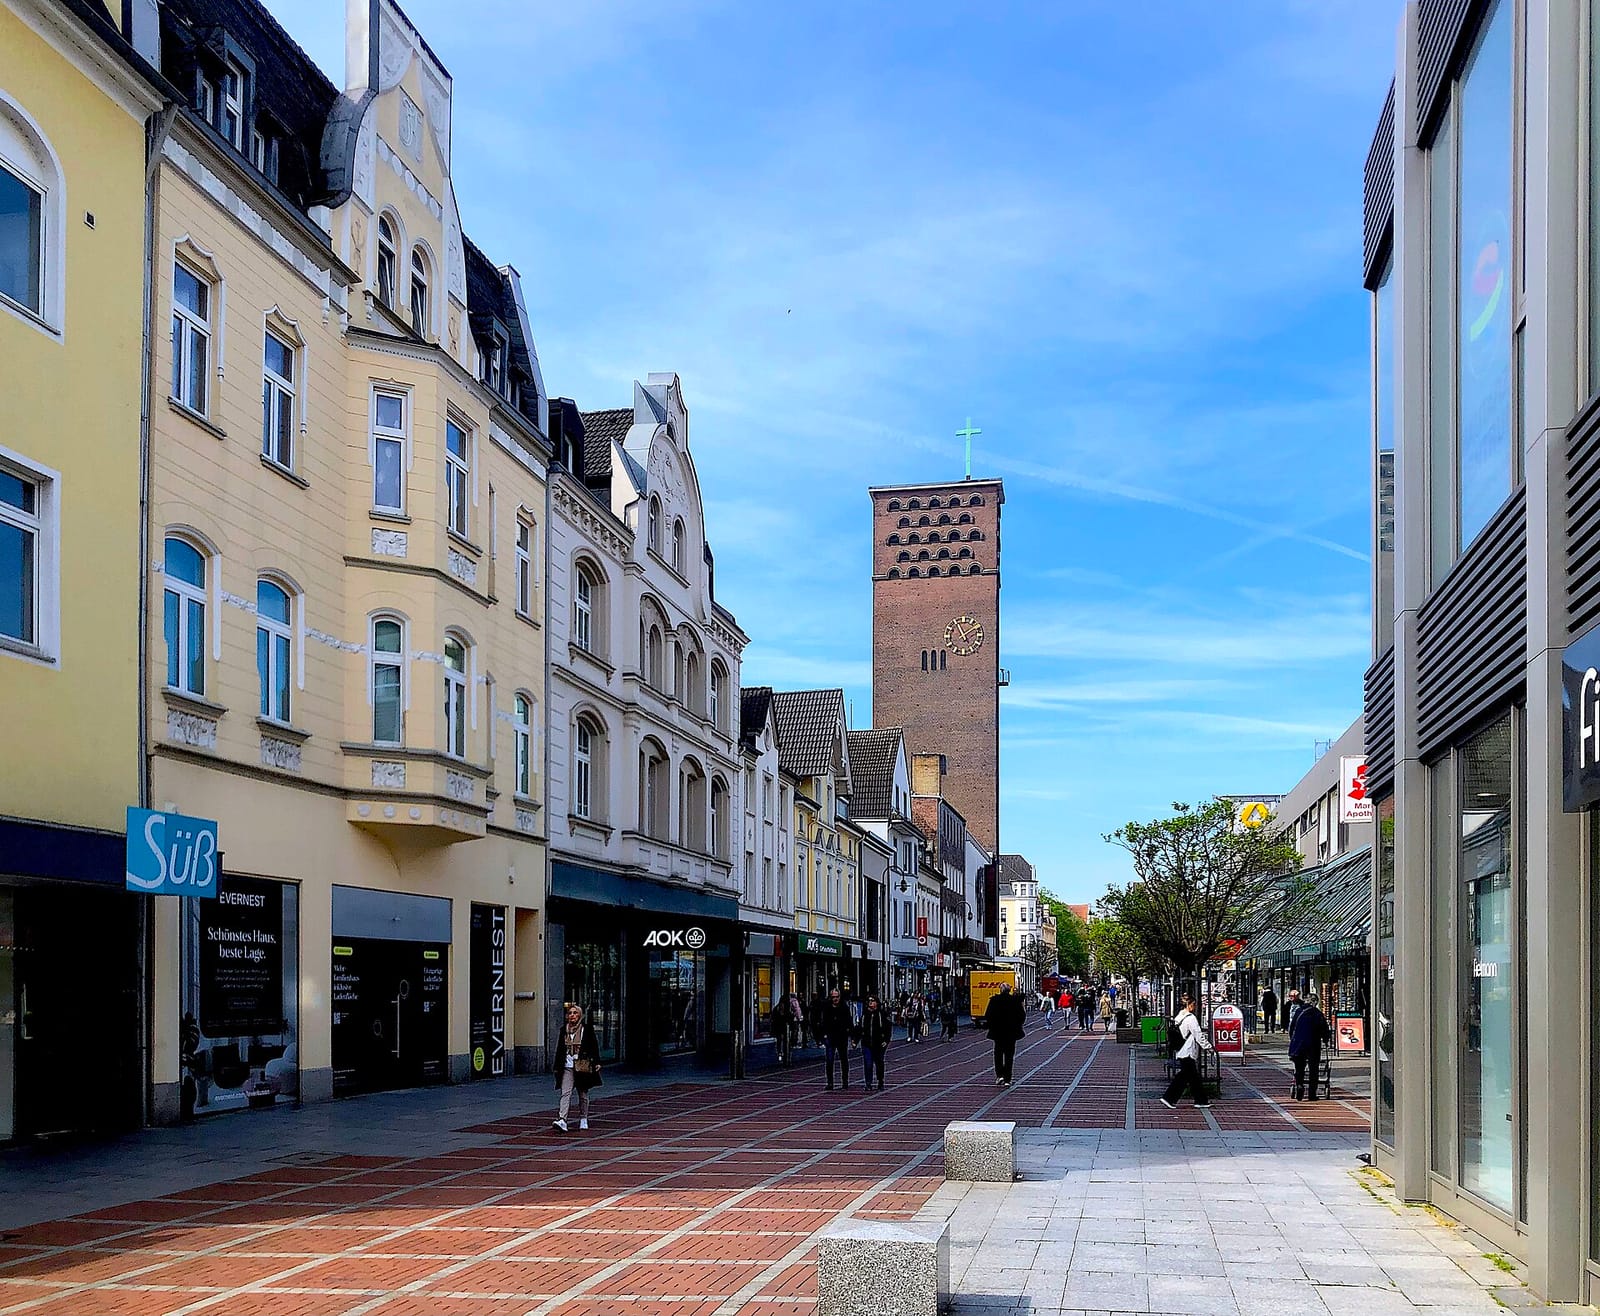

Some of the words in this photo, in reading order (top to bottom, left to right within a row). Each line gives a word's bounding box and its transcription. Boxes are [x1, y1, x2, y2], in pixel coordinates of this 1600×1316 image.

[127, 814, 215, 889] Süß
[219, 892, 265, 907] EVERNEST
[207, 926, 252, 942] Schönstes
[642, 929, 684, 947] AOK
[219, 943, 243, 958] beste
[244, 945, 266, 963] Lage.
[492, 909, 504, 1075] EVERNEST
